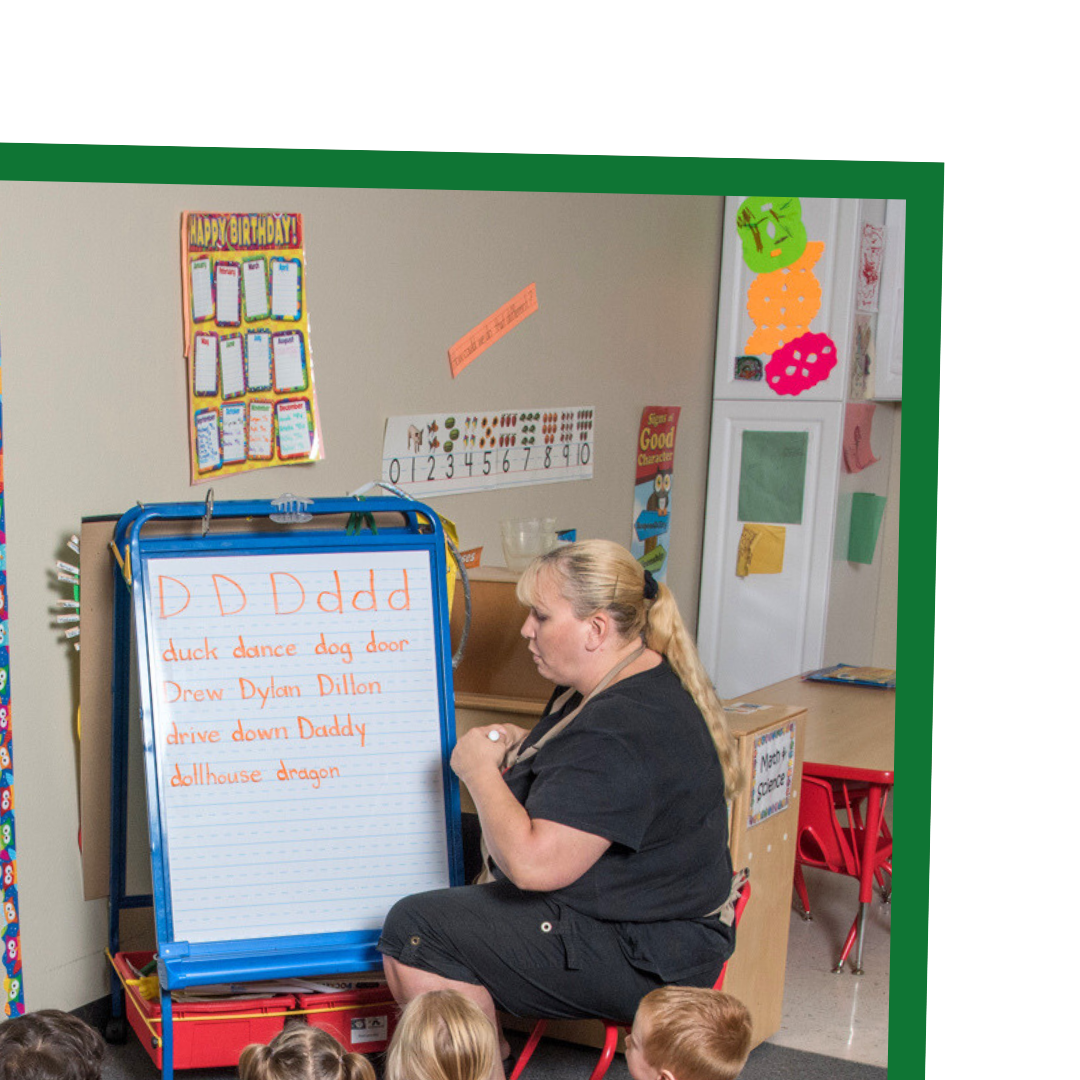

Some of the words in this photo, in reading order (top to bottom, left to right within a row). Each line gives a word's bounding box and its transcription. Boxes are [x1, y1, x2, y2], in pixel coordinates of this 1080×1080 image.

[190, 216, 227, 247] HAPPY
[230, 215, 298, 247] BIRTHDAY!
[640, 426, 675, 451] Good
[389, 458, 400, 484] 0
[411, 457, 416, 482] 1
[427, 456, 436, 481] 2
[445, 454, 455, 480] 3
[464, 453, 473, 477] 4
[482, 451, 492, 476] 5
[502, 450, 510, 473] 6
[522, 448, 531, 471] 7
[544, 446, 552, 469] 8
[562, 444, 570, 467] 9
[576, 442, 590, 466] 10
[637, 451, 673, 467] Character
[158, 574, 191, 619] D
[212, 573, 247, 617] D
[270, 571, 306, 615] D
[317, 570, 343, 614] d
[352, 568, 378, 612] d
[388, 568, 411, 611] d
[162, 638, 219, 662] duck
[232, 635, 298, 660] dance
[314, 632, 353, 664] dog
[366, 630, 410, 653] door
[162, 680, 224, 704] Drew
[238, 676, 302, 709] Dylan
[317, 673, 382, 698] Dillon
[166, 720, 221, 745] drive
[232, 718, 289, 743] down
[297, 713, 367, 748] Daddy
[170, 763, 264, 788] dollhouse
[276, 760, 341, 790] dragon
[760, 749, 780, 774] Math
